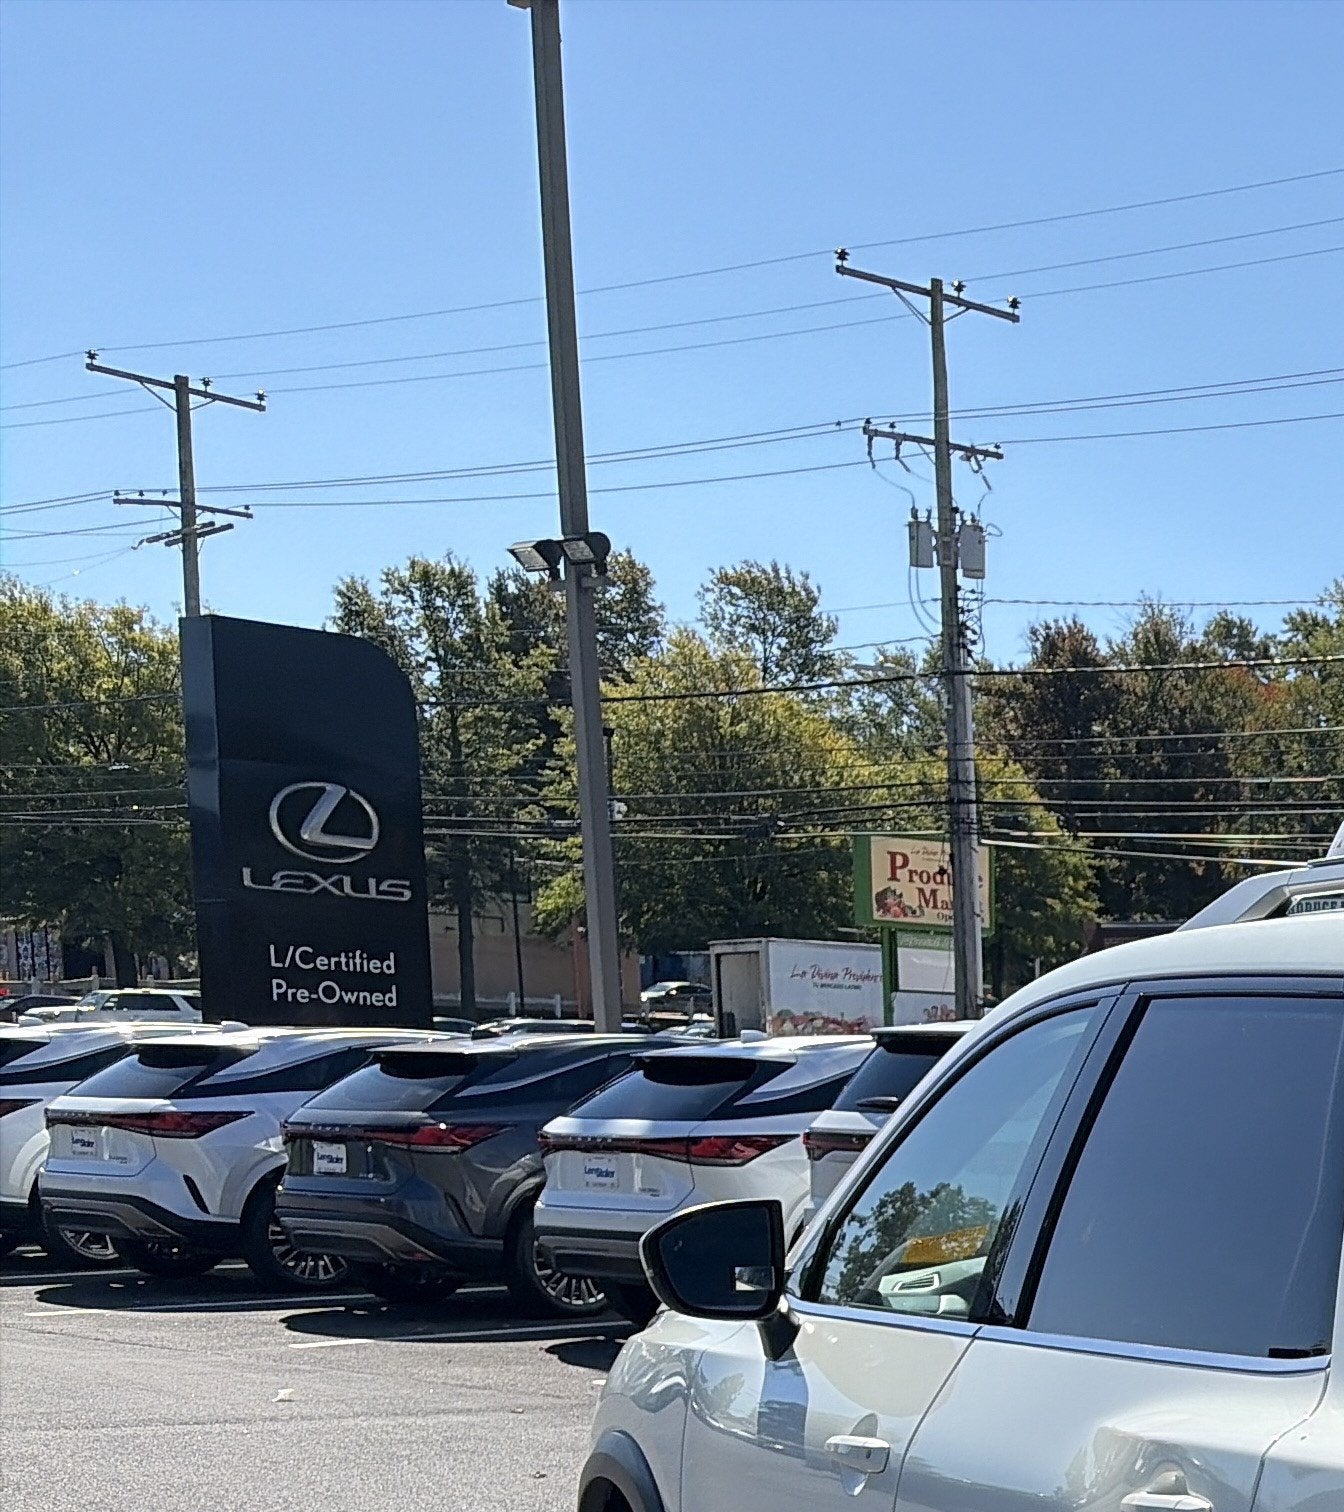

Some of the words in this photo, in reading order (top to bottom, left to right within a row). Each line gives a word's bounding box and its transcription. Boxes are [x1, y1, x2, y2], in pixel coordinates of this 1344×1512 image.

[242, 867, 412, 901] LEXUS
[269, 944, 395, 975] L/Certified
[272, 978, 397, 1007] Pre-Owned
